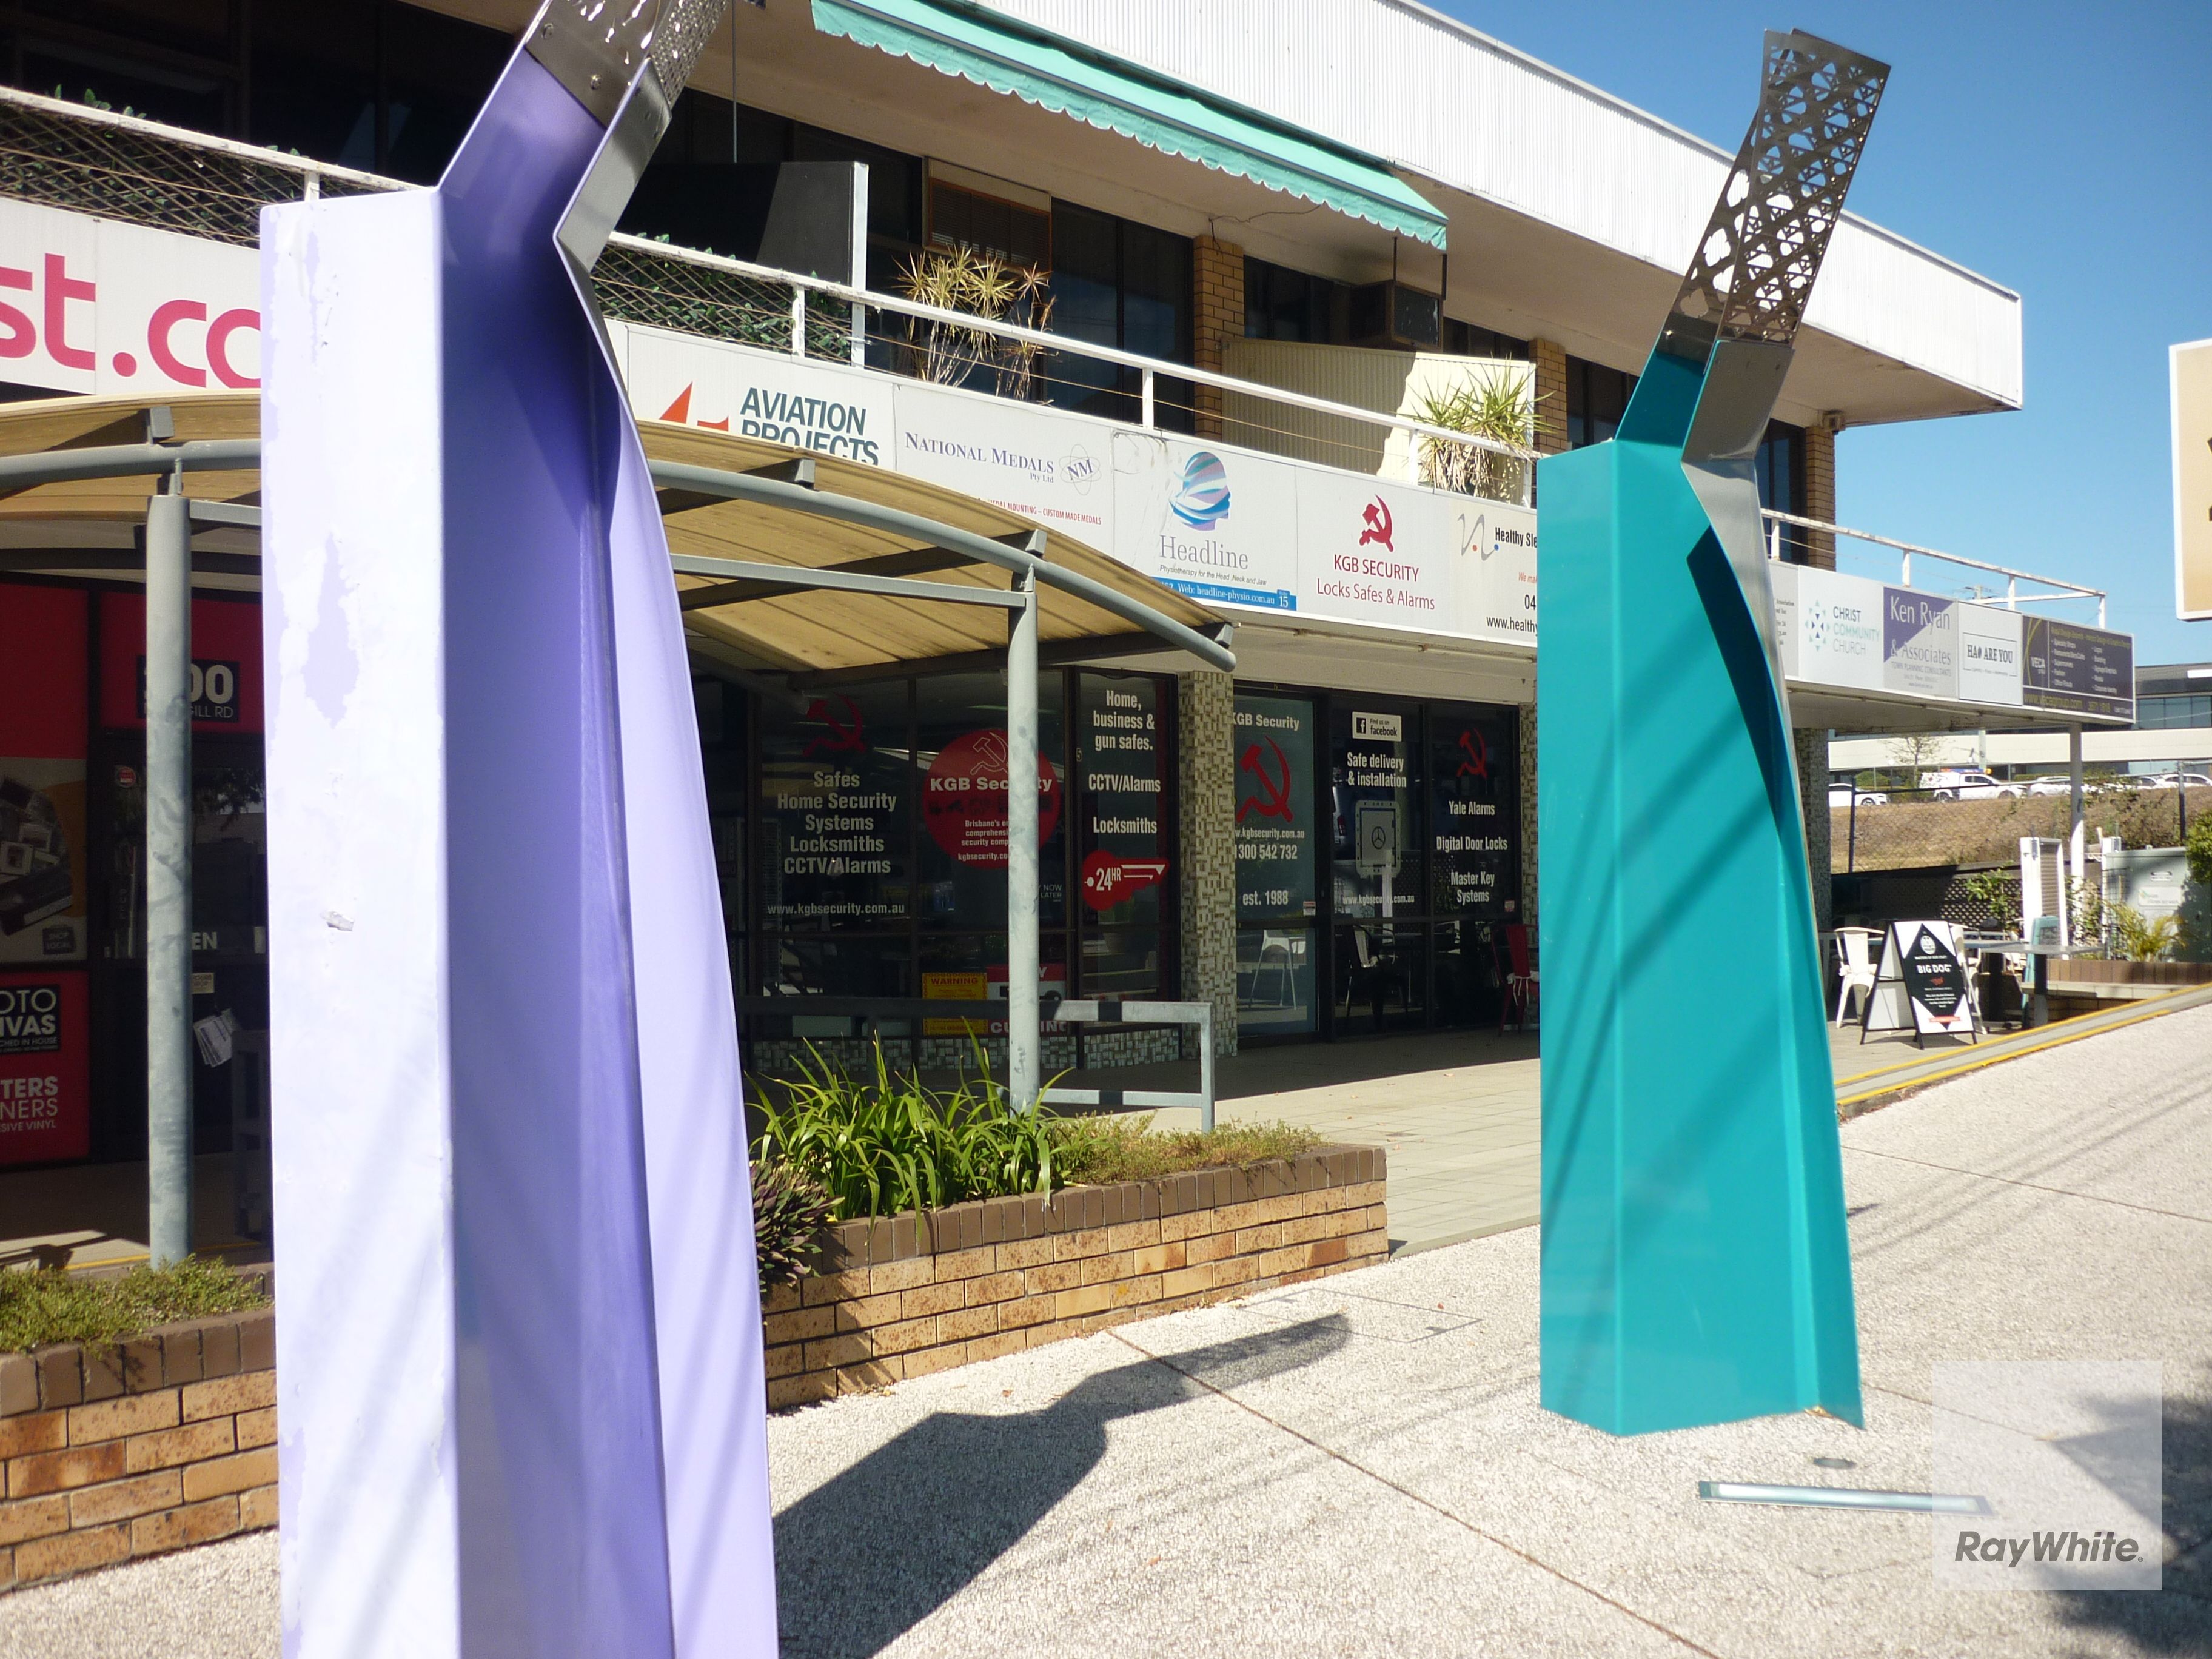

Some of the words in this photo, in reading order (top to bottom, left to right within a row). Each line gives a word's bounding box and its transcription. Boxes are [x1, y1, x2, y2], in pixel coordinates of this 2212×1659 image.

[740, 387, 866, 436] AVIATION
[905, 432, 987, 462] NATIONAL
[991, 447, 1054, 474] MEDALS
[1030, 472, 1041, 482] Pty
[1067, 459, 1093, 480] NM
[1007, 503, 1037, 514] MOUNTING
[1043, 508, 1064, 519] CUSTOM
[1065, 511, 1081, 521] MADE
[1081, 514, 1102, 525] MEDALS
[1495, 527, 1524, 547] Healthy
[1159, 534, 1248, 569] Headline
[1160, 565, 1197, 577] Physiotherapy
[1334, 554, 1359, 573] KGB
[1362, 558, 1419, 582] SECURITY
[1178, 583, 1195, 594] Web:
[1197, 586, 1275, 604] headline-physio.com.au
[1279, 596, 1289, 608] 15
[1317, 578, 1350, 598] Locks
[1354, 583, 1383, 603] Safes
[1386, 589, 1395, 604] &
[1398, 590, 1435, 610] Alarms
[1524, 594, 1537, 610] 04
[1833, 606, 1861, 622] CHRIST
[1891, 595, 1915, 624] Ken
[1920, 602, 1951, 635] Ryan
[1833, 623, 1880, 642] COMMUNITY
[1832, 638, 1866, 655] CHURCH
[1891, 639, 1898, 657] &
[1901, 640, 1951, 666] Associates
[1984, 647, 1997, 662] ARE
[1999, 649, 2013, 664] YOU
[1106, 690, 1142, 711] Home,
[215, 706, 233, 718] RD
[1093, 711, 1143, 729] business
[1146, 713, 1155, 730] &
[1256, 714, 1300, 731] Security
[1370, 725, 1397, 736] facebook
[1095, 734, 1116, 751] gun
[1119, 734, 1153, 751] safes.
[1347, 751, 1367, 768] Safe
[1369, 753, 1404, 773] delivery
[814, 770, 860, 788] Safes
[930, 777, 970, 791] KGB
[1088, 773, 1161, 793] CCTV/Alarms
[1347, 770, 1355, 786] &
[1358, 771, 1407, 788] installation
[777, 794, 823, 810] Home
[828, 793, 897, 812] Security
[1449, 800, 1466, 815] Yale
[1468, 800, 1495, 816] Alarms
[805, 814, 874, 834] Systems
[1093, 816, 1158, 834] Locksmiths
[790, 836, 885, 853] Locksmiths
[961, 839, 989, 847] security
[1259, 843, 1278, 860] 542
[1280, 844, 1298, 860] 732
[1436, 836, 1463, 853] Digital
[1465, 836, 1484, 850] Door
[1485, 836, 1508, 850] Locks
[958, 852, 1008, 861] kgbsecurity.co
[784, 857, 891, 875] CCTV/Alarms
[1451, 871, 1478, 886] Master
[1480, 871, 1495, 887] Key
[1242, 890, 1262, 906] est.
[1265, 890, 1289, 905] 1988
[1456, 889, 1489, 906] Systems
[768, 902, 905, 916] www.kgbsecurity.com.au
[1917, 965, 1931, 974] BIG
[1932, 964, 1951, 973] DOG
[931, 977, 979, 985] WARNING
[25, 1119, 56, 1130] VINYL
